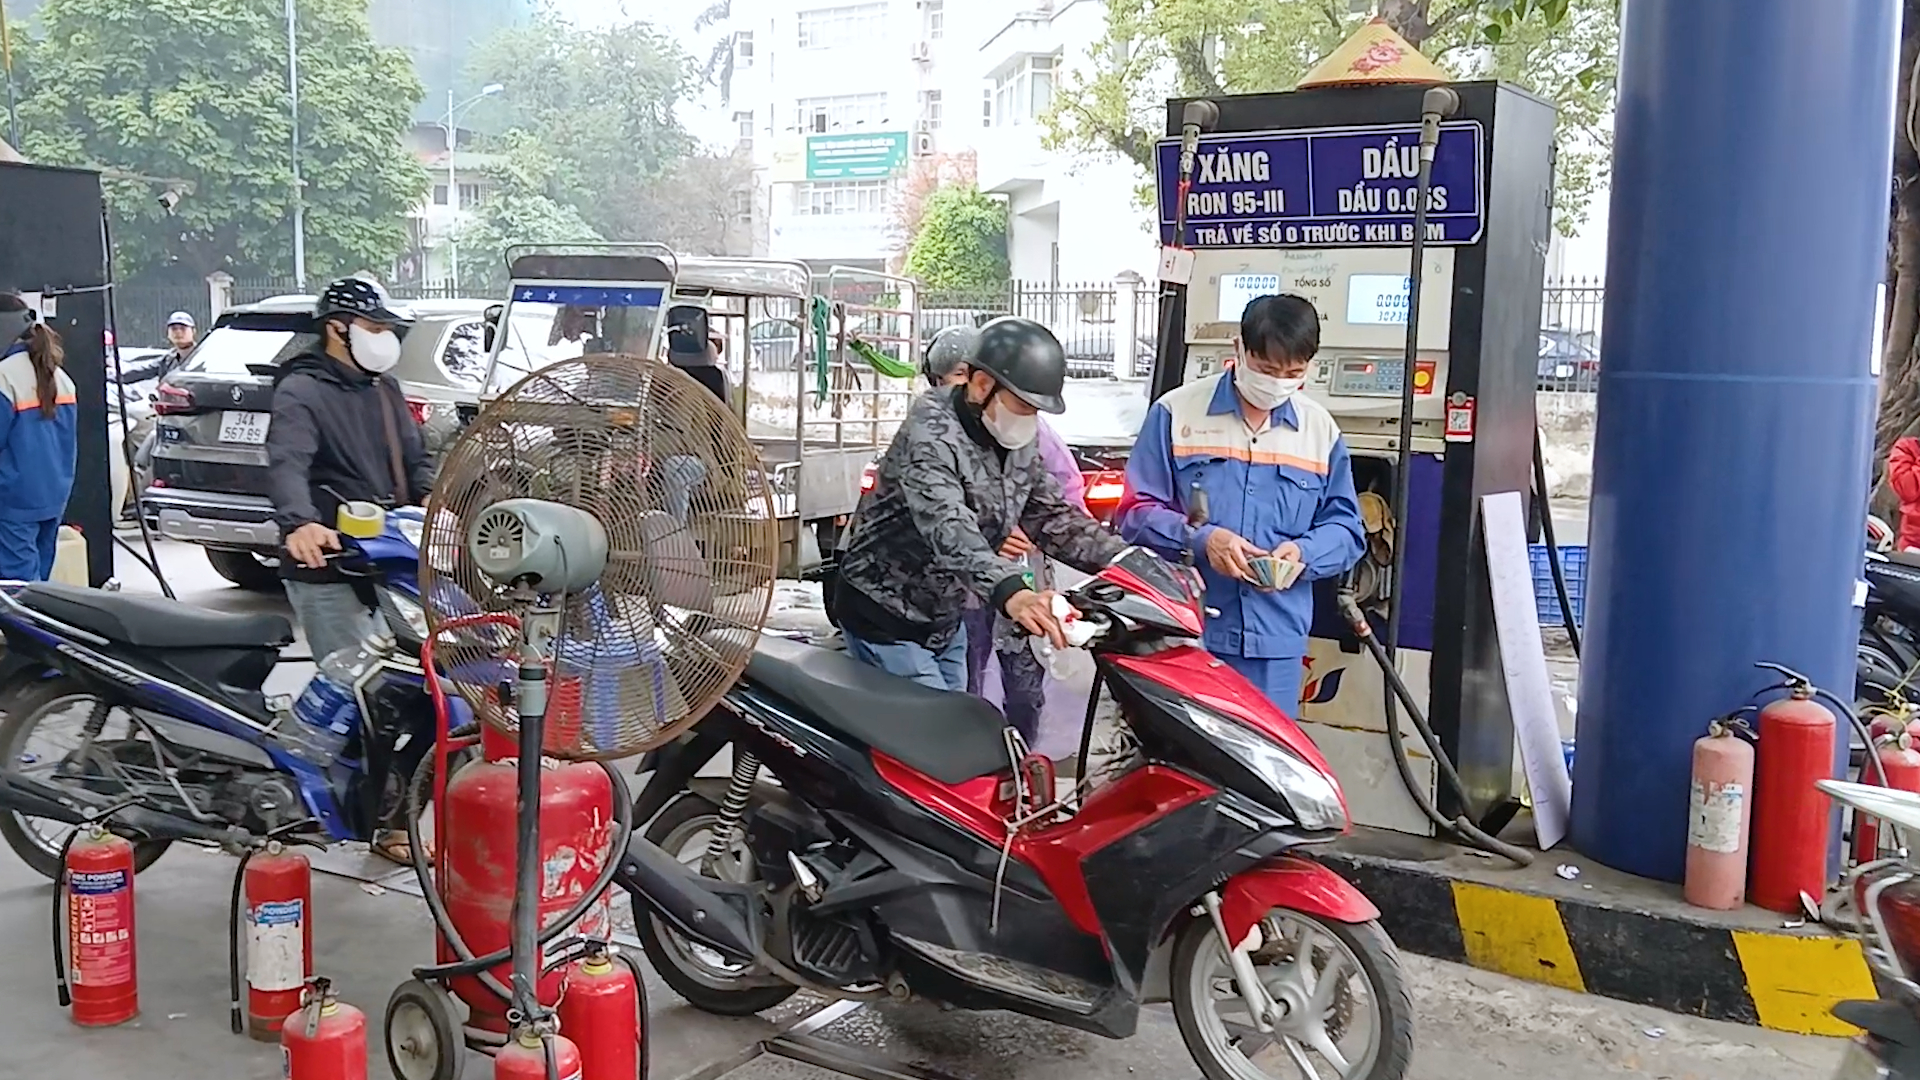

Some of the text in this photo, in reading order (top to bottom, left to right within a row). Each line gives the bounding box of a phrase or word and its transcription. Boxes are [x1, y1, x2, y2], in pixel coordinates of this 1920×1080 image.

[1197, 146, 1271, 184] XĂNG
[1362, 135, 1420, 179] DẦU
[1187, 189, 1285, 216] RON 95-III
[1338, 181, 1381, 213] DẦU
[1195, 223, 1229, 245] TRẢ
[1258, 221, 1282, 243] SỐ
[1301, 221, 1361, 243] TRƯỚC
[1364, 223, 1397, 242] KHI
[1400, 222, 1445, 242] BM
[235, 412, 255, 426] 34A
[86, 870, 123, 882] POWDER
[263, 904, 300, 916] POWDER
